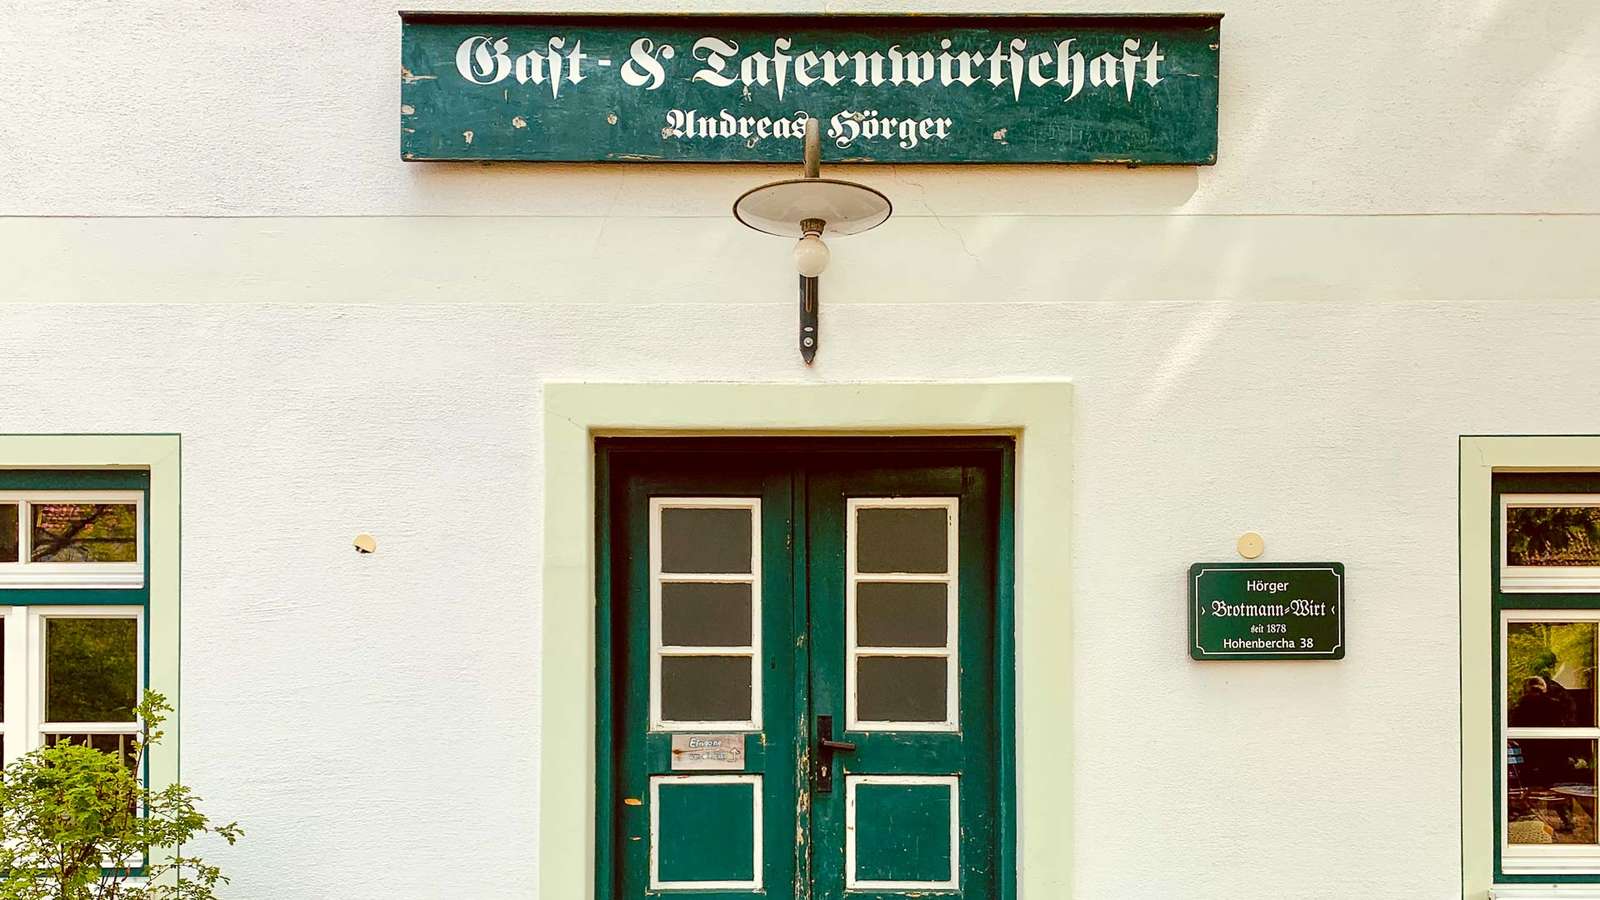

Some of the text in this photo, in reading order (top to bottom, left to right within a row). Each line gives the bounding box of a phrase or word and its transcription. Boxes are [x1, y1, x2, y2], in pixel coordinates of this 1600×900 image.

[620, 37, 675, 91] &
[666, 109, 954, 150] Andreas Hörger
[1246, 580, 1289, 593] Hörger
[1267, 623, 1287, 634] 1878
[1223, 637, 1314, 649] Hohenbercha 38
